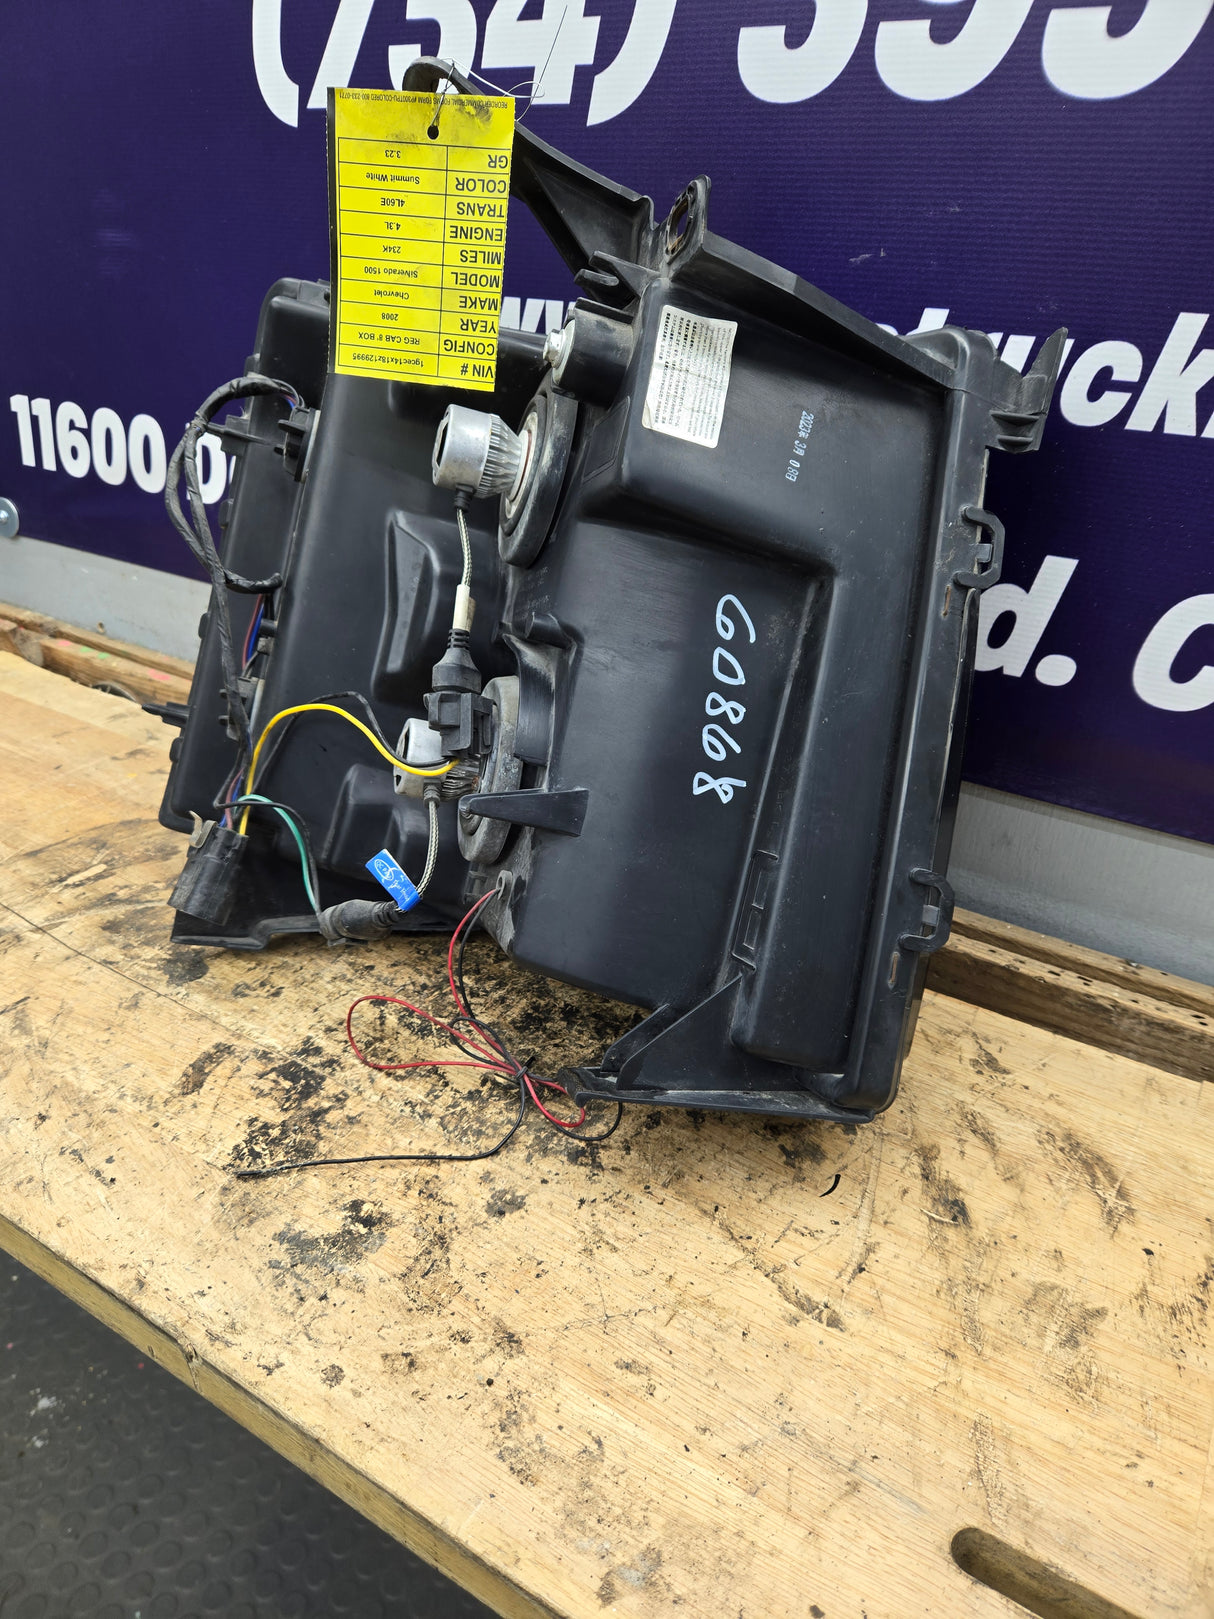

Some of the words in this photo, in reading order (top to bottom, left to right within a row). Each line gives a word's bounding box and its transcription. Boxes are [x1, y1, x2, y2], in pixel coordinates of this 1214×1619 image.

[384, 149, 401, 159] 3.23
[488, 154, 508, 169] GR
[365, 172, 389, 182] White
[390, 174, 420, 185] Summit
[455, 177, 507, 194] COLOR
[380, 197, 406, 208] 4L60E
[456, 201, 505, 218] TRANS
[384, 221, 401, 231] 4.3L
[449, 225, 503, 242] ENGINE
[382, 244, 402, 254] 234K
[460, 249, 502, 265] MILES
[364, 265, 382, 275] 1500
[383, 267, 419, 278] Silverado
[451, 271, 500, 288] MODEL
[373, 288, 410, 300] Chevrolet
[458, 295, 499, 311] MAKE
[381, 312, 399, 322] 2008
[459, 317, 497, 334] YEAR
[358, 331, 375, 341] BOX
[385, 333, 402, 344] CAB
[403, 335, 421, 346] REG
[443, 338, 495, 356] CONFIG
[460, 362, 469, 376] #
[472, 363, 494, 379] VIN
[9, 393, 167, 494] 11600
[692, 593, 757, 805] 60868
